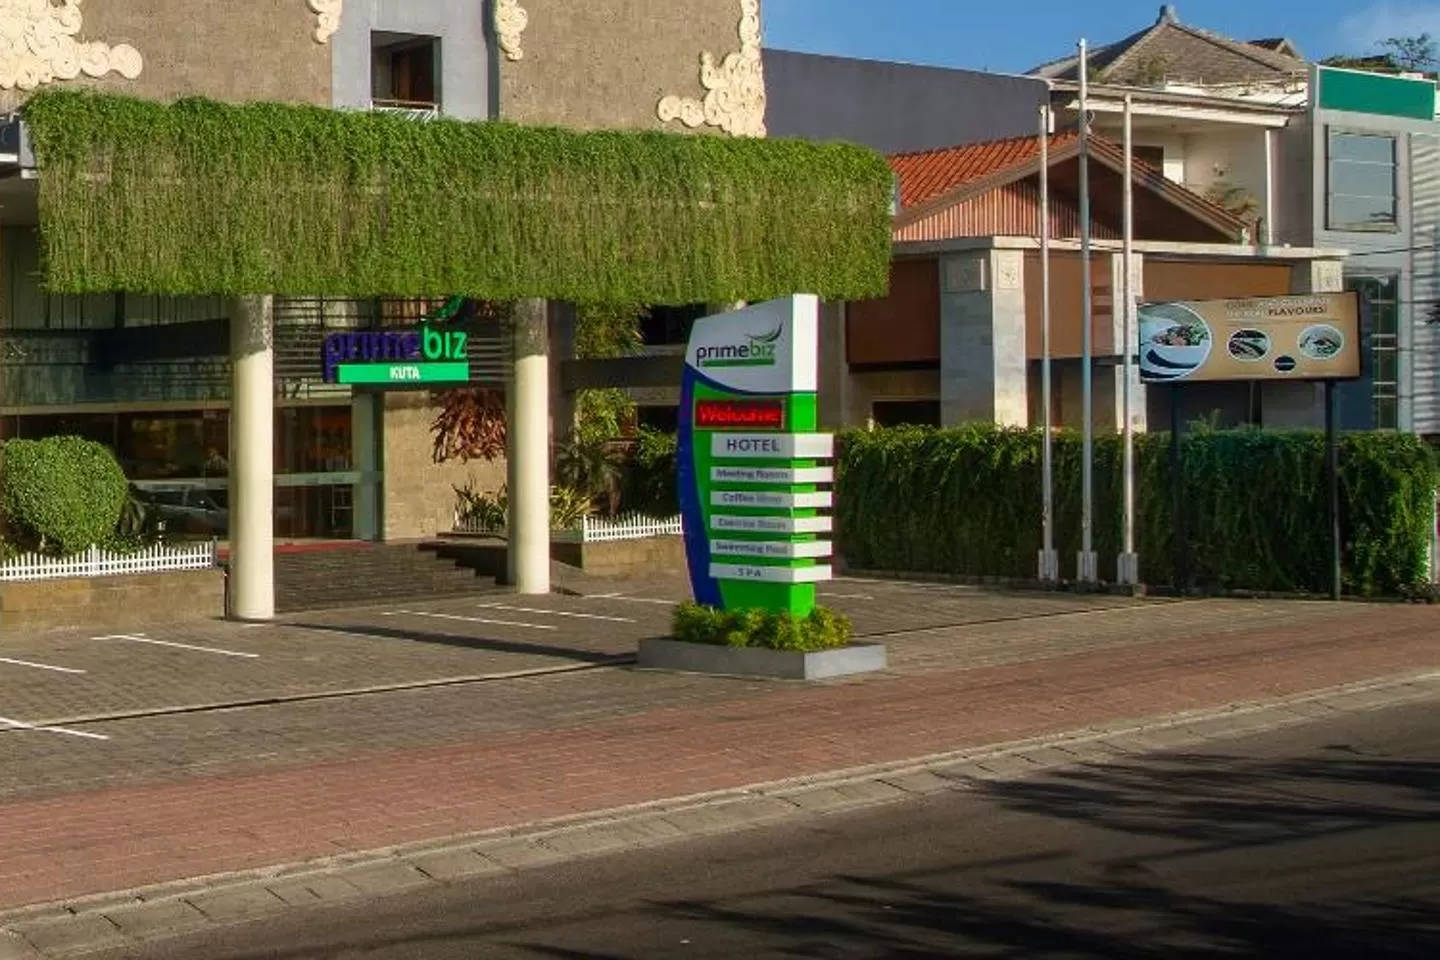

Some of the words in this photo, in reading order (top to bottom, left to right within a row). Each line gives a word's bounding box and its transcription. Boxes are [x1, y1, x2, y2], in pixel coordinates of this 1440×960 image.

[322, 325, 468, 383] primebiz
[696, 340, 775, 368] primebiz
[389, 366, 421, 380] KUTA
[726, 439, 781, 452] HOTEL
[738, 567, 762, 577] SPA
